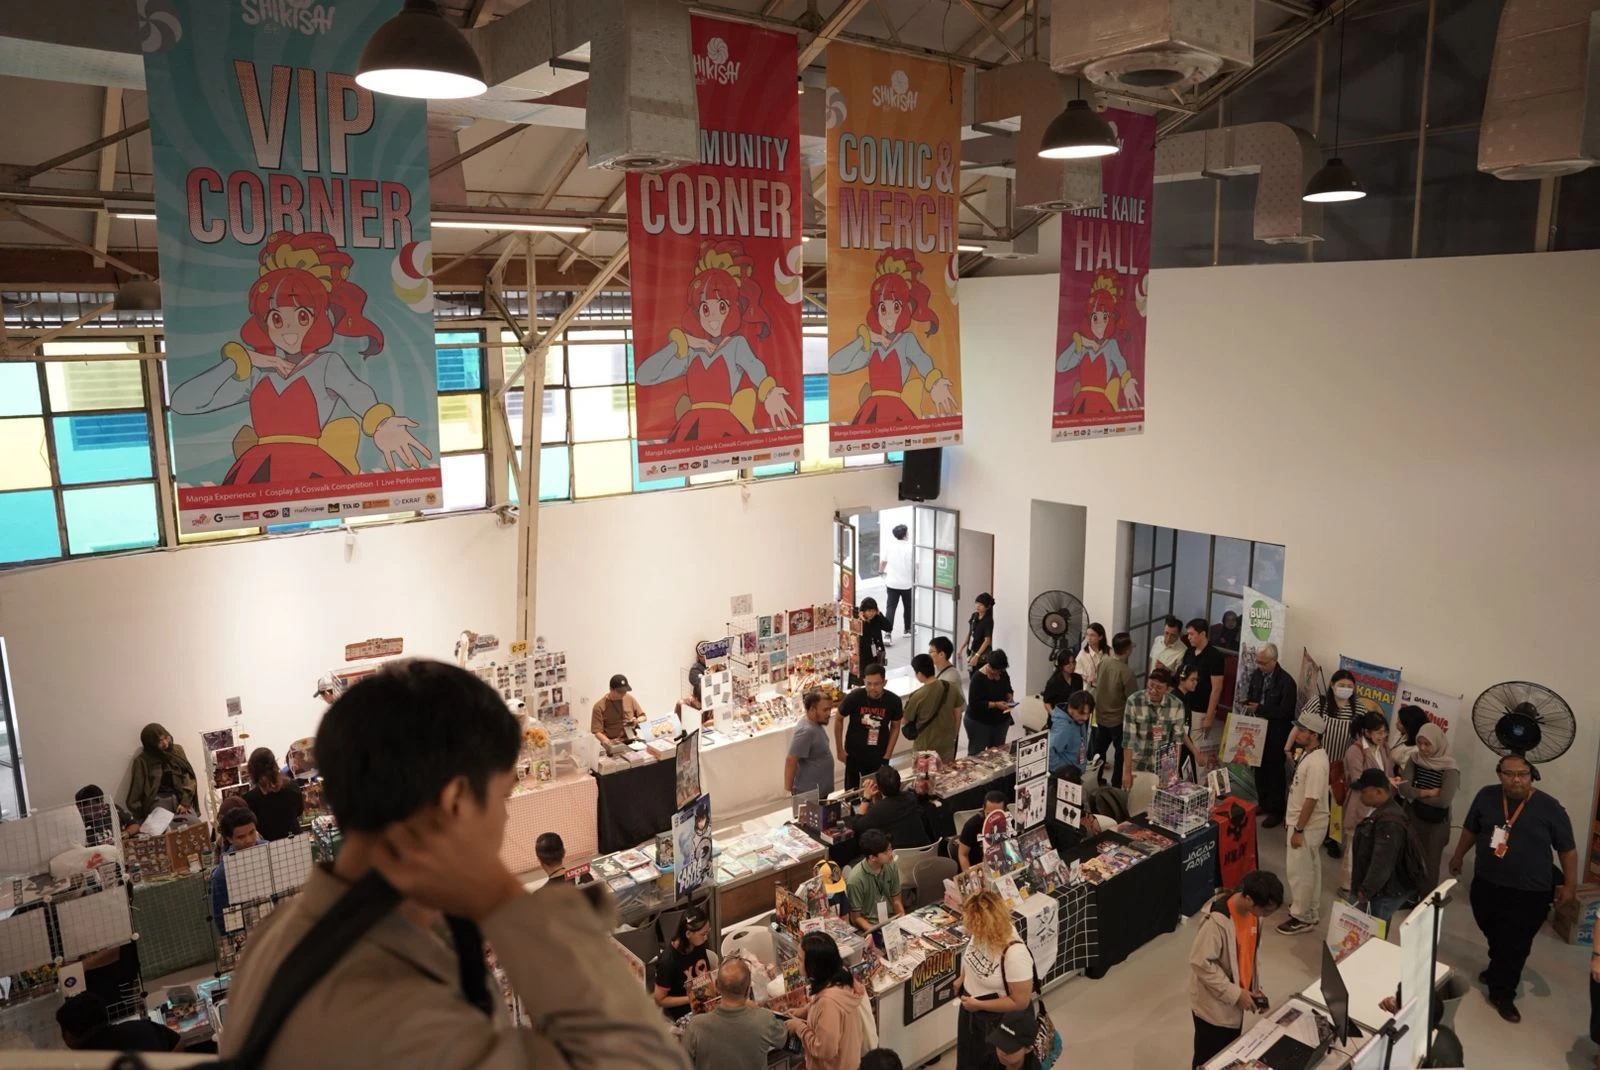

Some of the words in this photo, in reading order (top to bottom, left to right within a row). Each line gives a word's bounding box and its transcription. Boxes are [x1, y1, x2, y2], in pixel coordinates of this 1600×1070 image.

[233, 59, 375, 175] VIP
[700, 128, 789, 172] MUNITY
[838, 133, 933, 191] COMIC
[936, 140, 954, 194] &
[186, 167, 413, 249] CORNER
[640, 173, 792, 239] CORNER
[839, 187, 957, 254] MERCH
[1075, 220, 1138, 275] HALL
[186, 495, 213, 504] Manga
[215, 491, 256, 502] Experience
[265, 486, 293, 497] Cosplay
[301, 483, 330, 493] Coswalk
[331, 480, 373, 491] Competition
[396, 475, 436, 485] Performance
[1249, 617, 1272, 630] LANGIT
[1250, 607, 1271, 620] BUMI
[1356, 684, 1395, 704] KAMA!
